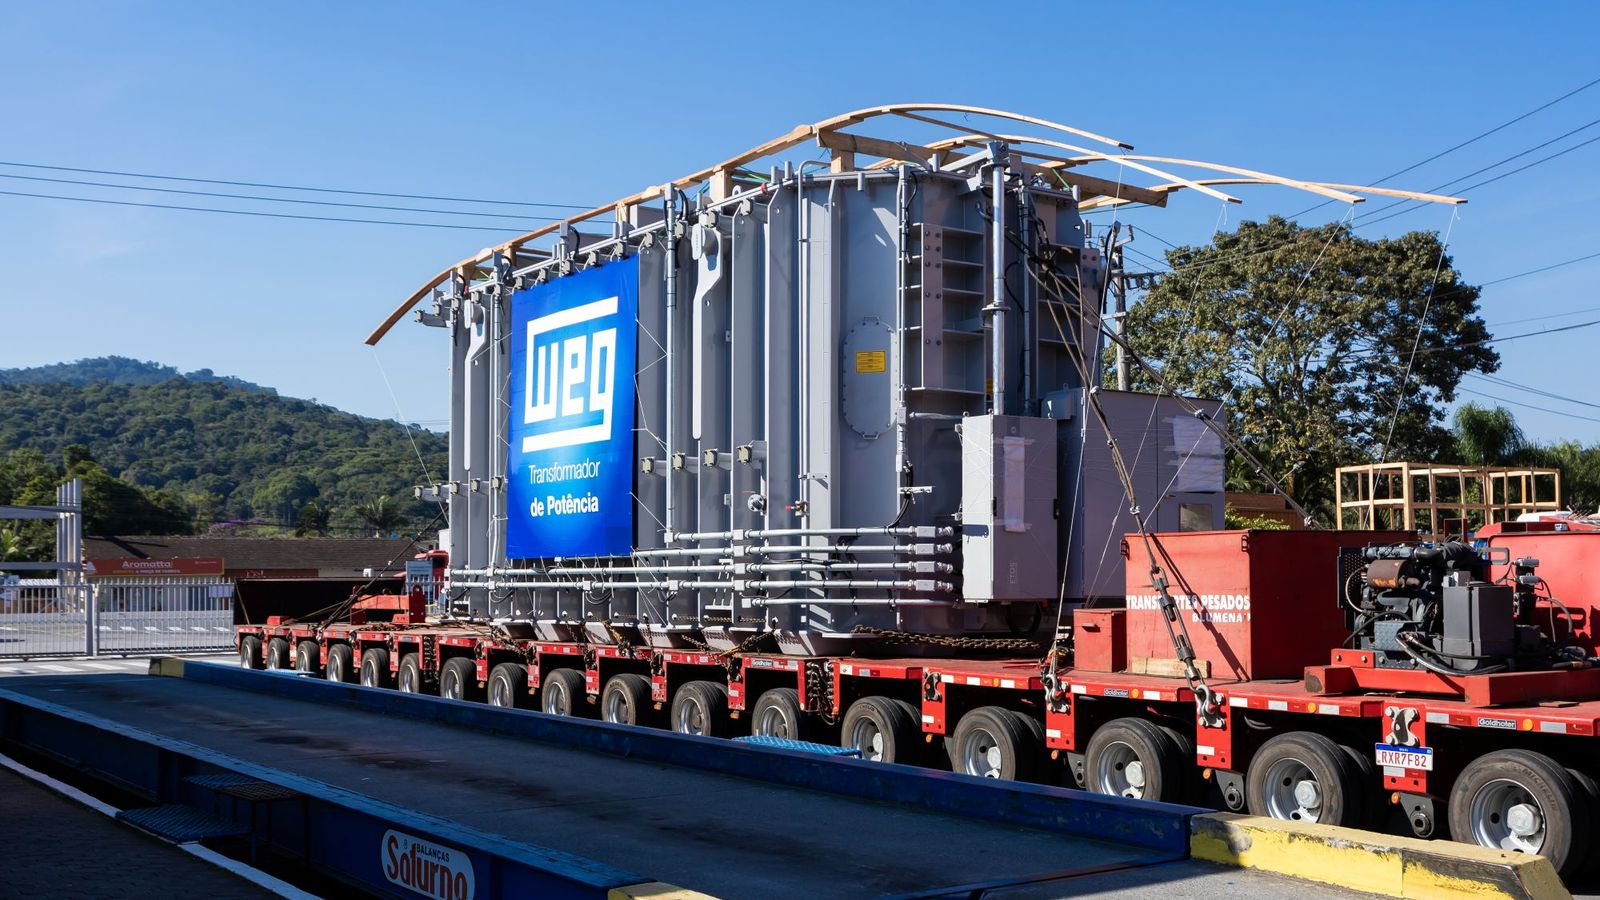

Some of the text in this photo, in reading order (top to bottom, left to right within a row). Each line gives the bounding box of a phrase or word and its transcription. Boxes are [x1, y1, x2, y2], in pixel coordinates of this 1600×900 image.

[529, 458, 600, 484] Transformador
[530, 492, 599, 517] de Potência
[122, 560, 171, 568] Aromatta
[1201, 594, 1250, 610] PESADOS
[1479, 718, 1515, 728] Goldhofer
[1381, 751, 1427, 767] RXR7F82
[416, 844, 450, 862] BALANÇAS
[386, 835, 468, 900] Saturno
